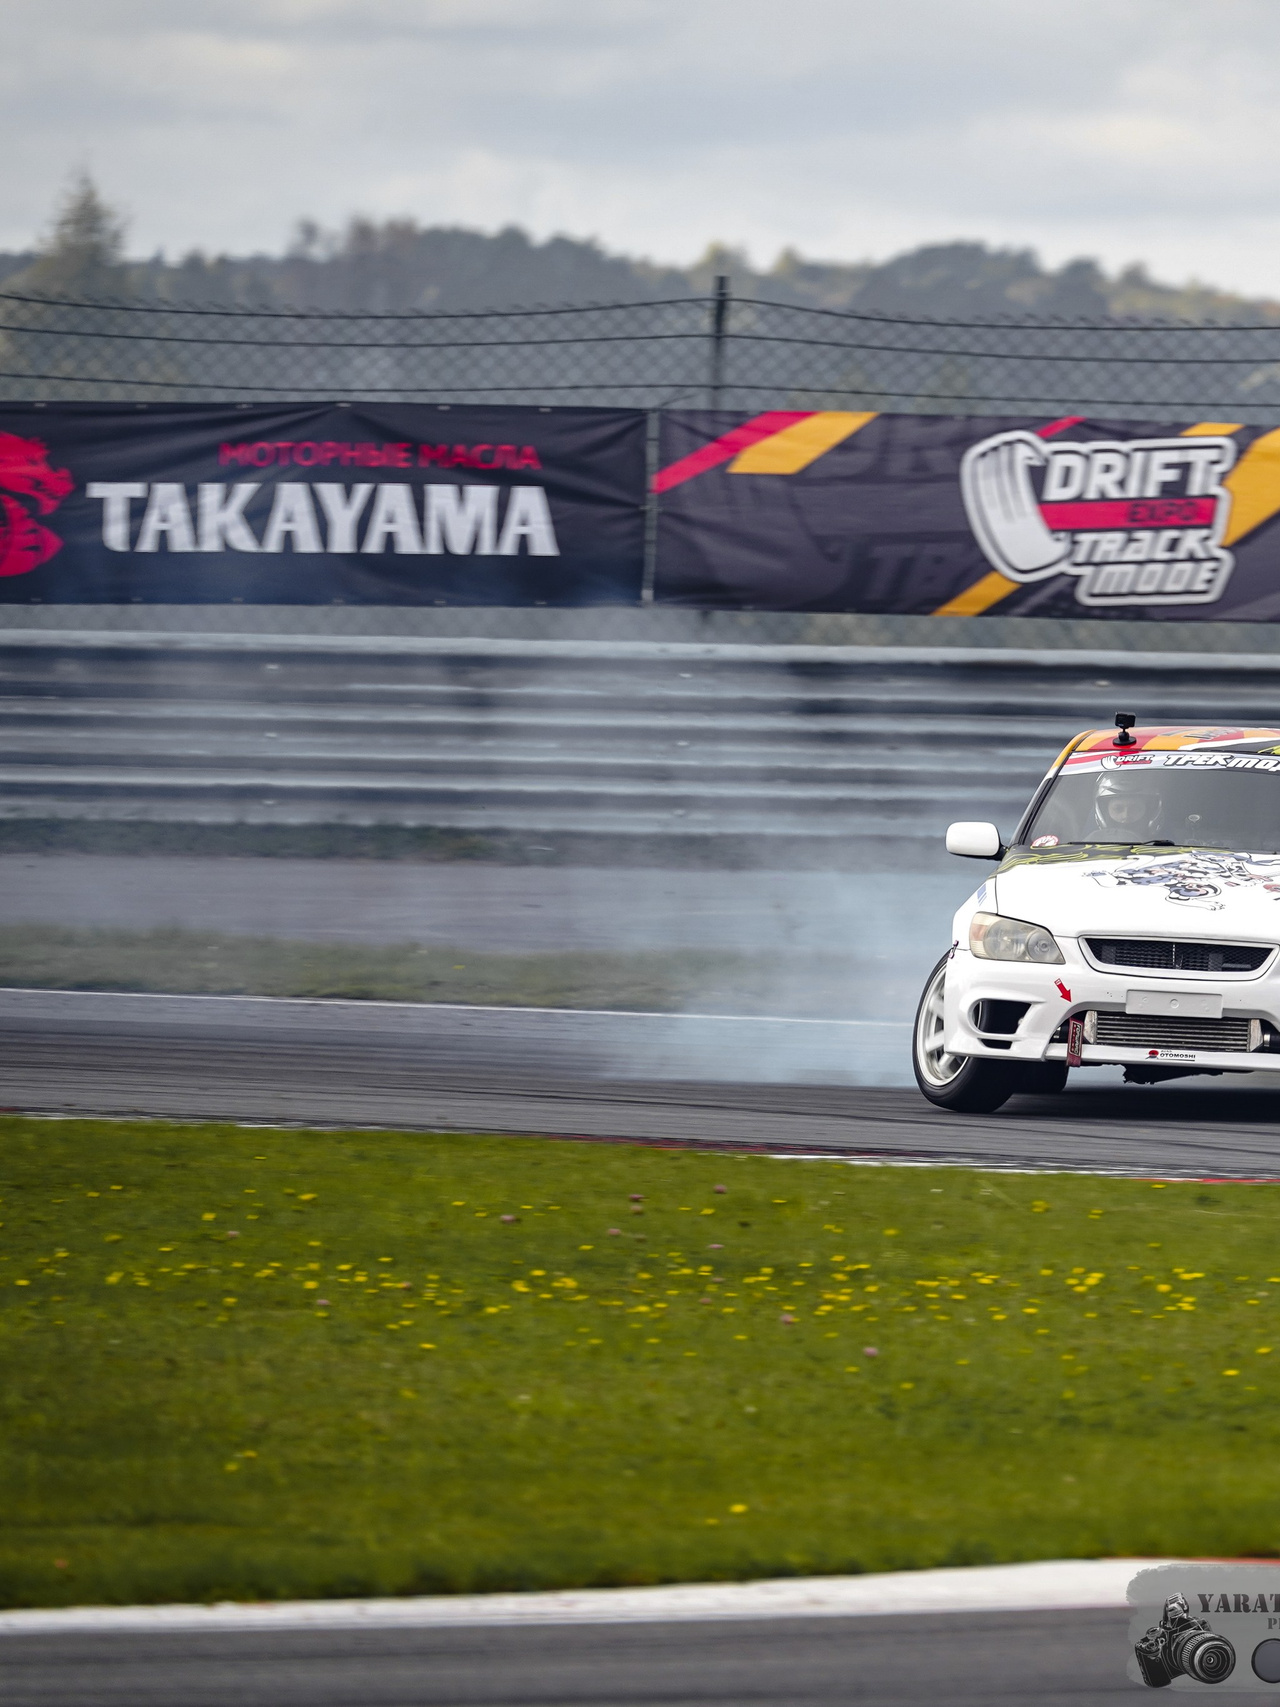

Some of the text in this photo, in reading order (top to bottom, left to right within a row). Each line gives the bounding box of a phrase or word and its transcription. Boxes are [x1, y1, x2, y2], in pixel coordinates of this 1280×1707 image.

[218, 441, 542, 470] МОТОРНЫЕ МАСЛА
[1042, 449, 1222, 501] DRIFT
[86, 481, 560, 556] TAKAYAMA
[1115, 755, 1155, 763] DRIFT
